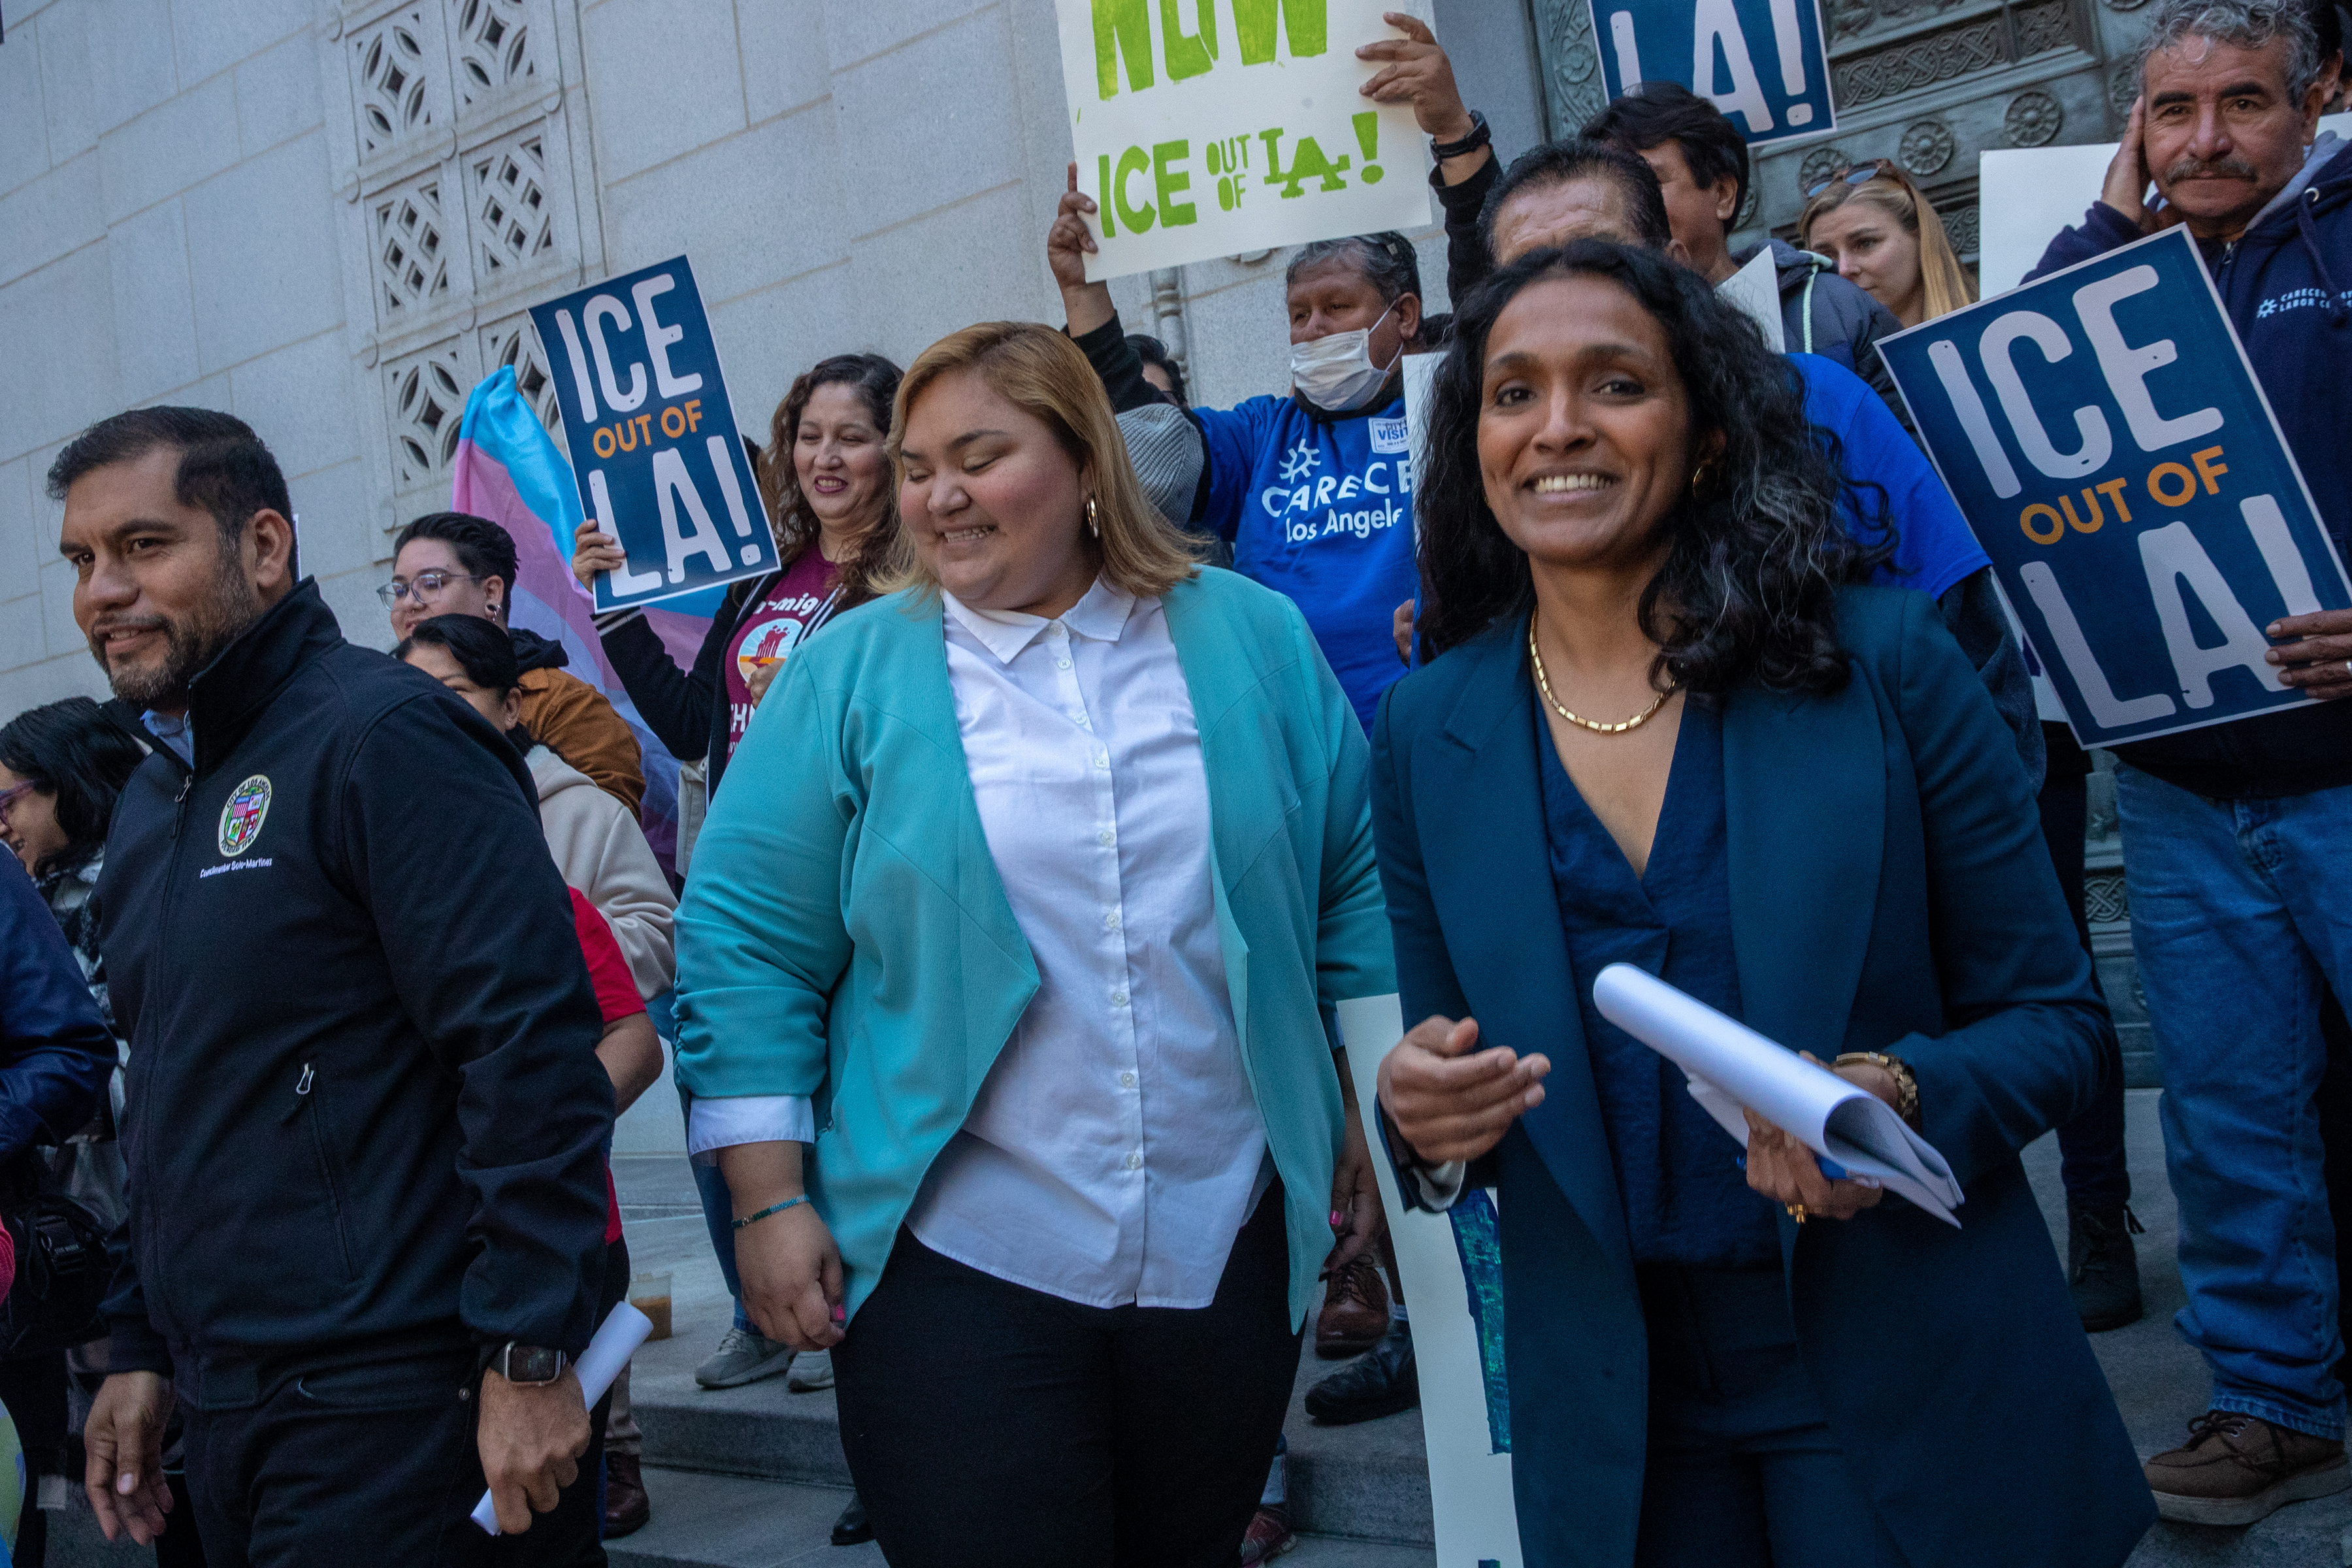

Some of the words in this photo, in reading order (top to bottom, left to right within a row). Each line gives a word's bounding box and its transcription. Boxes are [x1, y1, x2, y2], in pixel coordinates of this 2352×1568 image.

[1098, 139, 1197, 238] ICE
[1206, 134, 1250, 176] OUT
[1217, 174, 1246, 212] OF
[2279, 298, 2315, 312] LABOR
[555, 273, 703, 423] ICE
[1927, 264, 2225, 499] ICE
[593, 414, 652, 458] OUT
[661, 399, 702, 438] OF
[589, 435, 762, 598] LA!
[2019, 478, 2132, 545] OUT
[2147, 446, 2229, 507] OF
[227, 791, 238, 809] CITY
[248, 777, 259, 787] LOS
